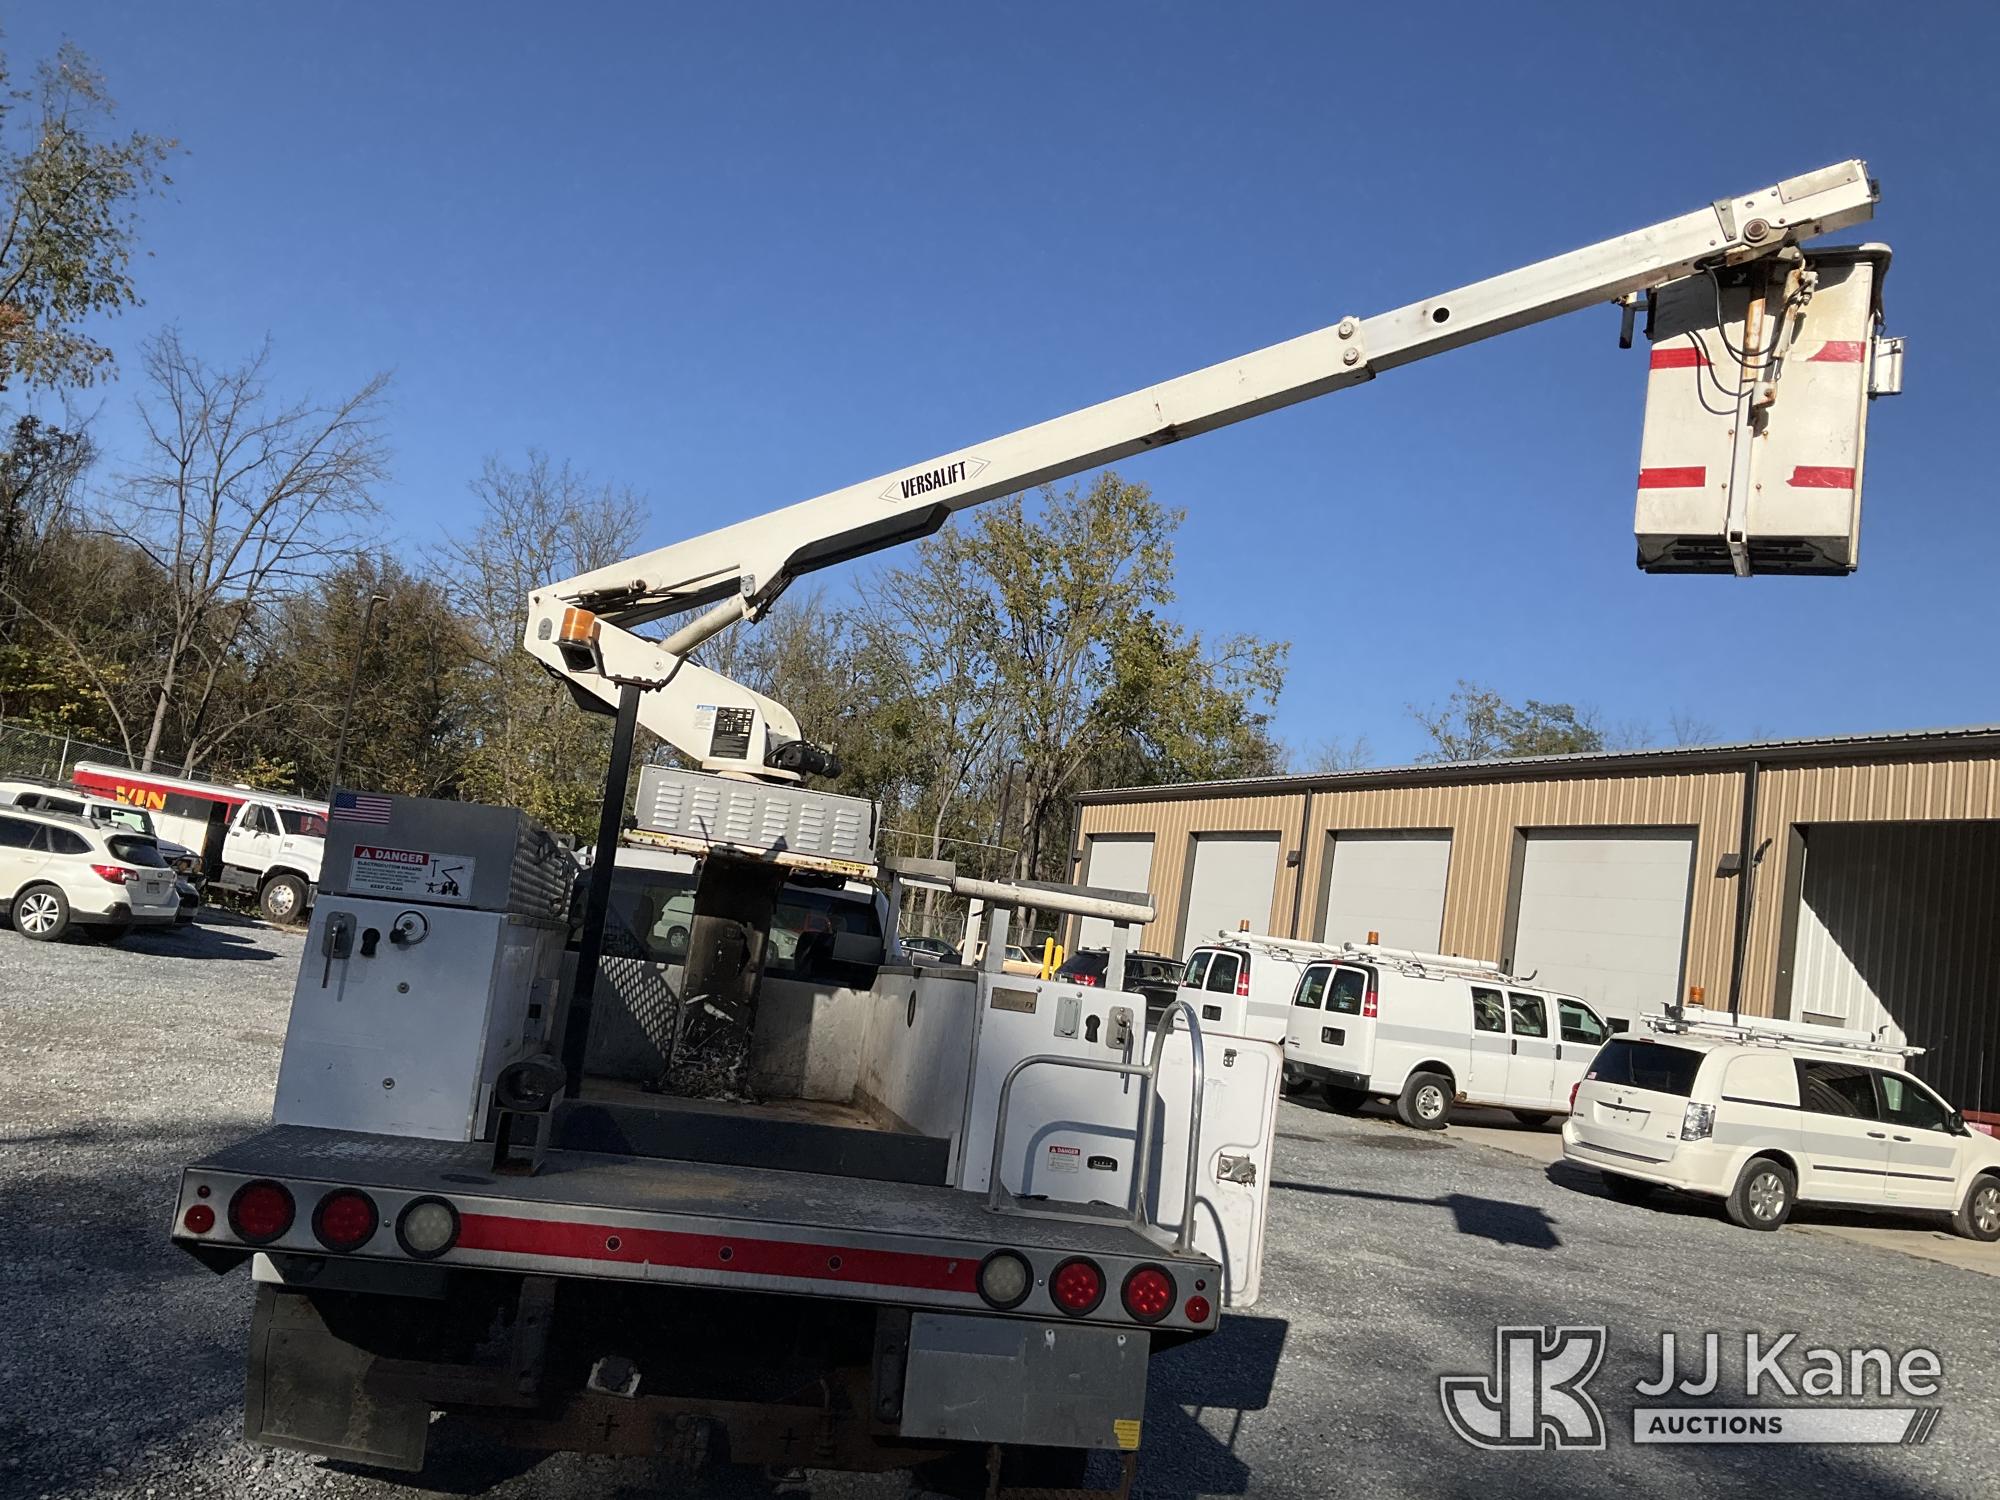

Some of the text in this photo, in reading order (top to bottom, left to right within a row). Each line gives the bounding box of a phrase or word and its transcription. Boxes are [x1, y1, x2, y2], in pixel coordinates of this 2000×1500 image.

[901, 461, 966, 499] VERSALIFT
[375, 850, 424, 864] DANGER
[1057, 1147, 1079, 1156] DANGER
